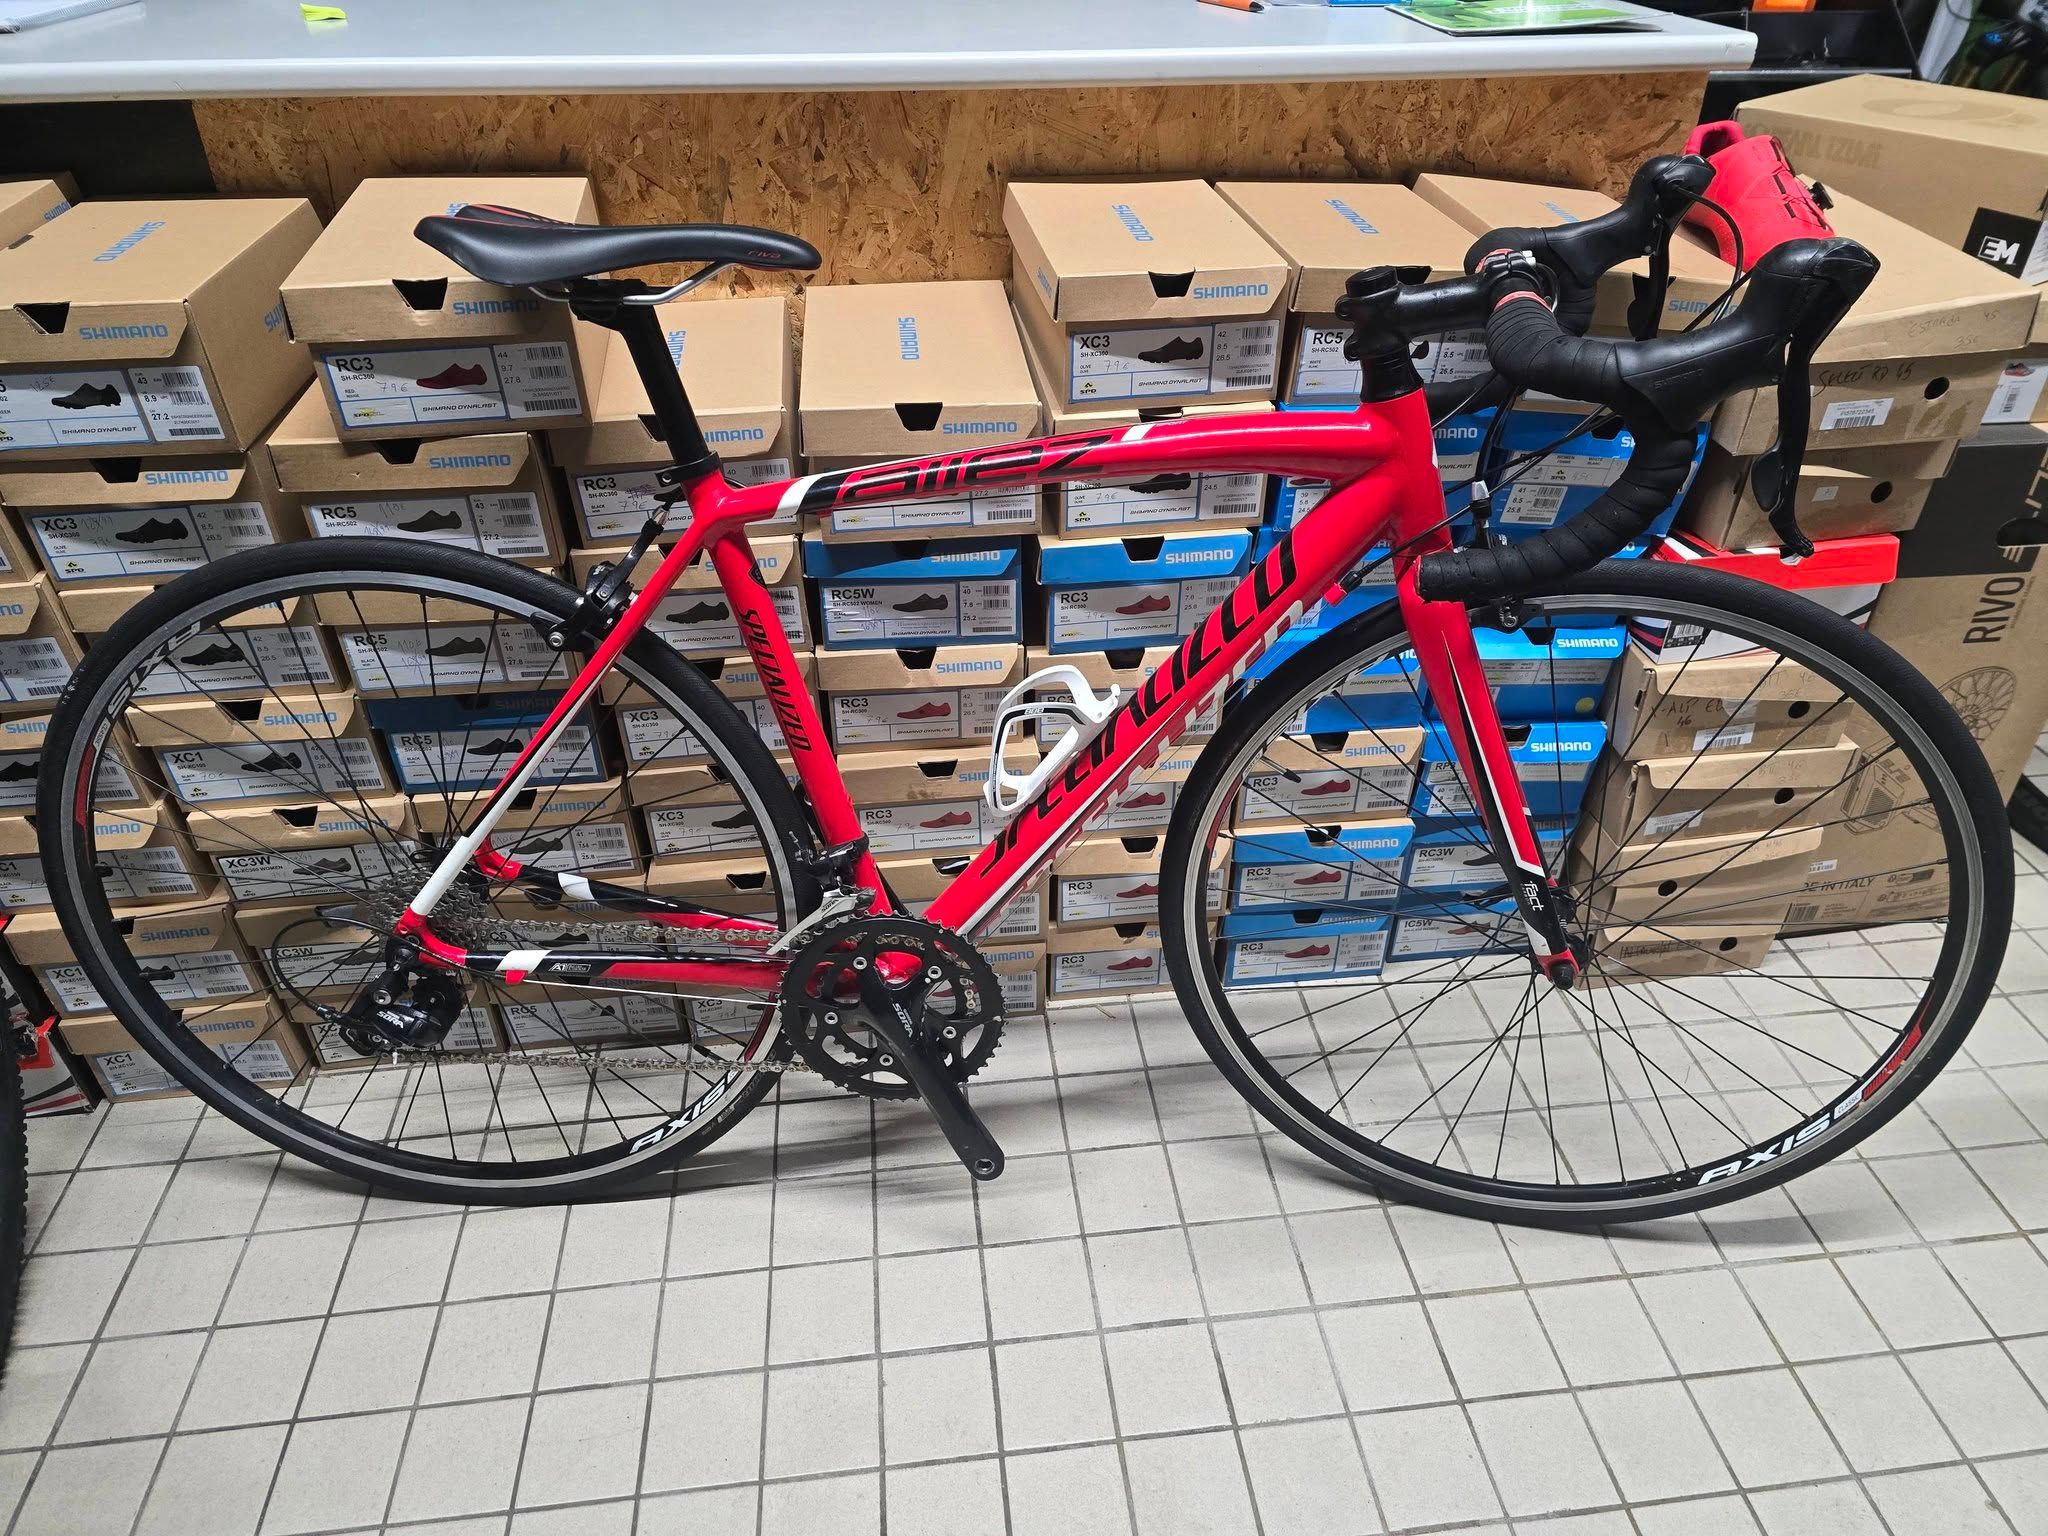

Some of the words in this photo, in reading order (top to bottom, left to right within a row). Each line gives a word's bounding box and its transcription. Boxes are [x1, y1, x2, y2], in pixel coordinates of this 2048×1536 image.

[1112, 204, 1154, 242] SHIMANO
[1325, 199, 1379, 235] SHIMANO
[94, 220, 166, 262] SHIMANO
[1193, 284, 1268, 299] SHIMANO
[453, 301, 541, 315] SHIMANO
[79, 324, 169, 341] SHIMANO
[1312, 332, 1343, 344] RC5
[898, 317, 920, 361] SHIMANO
[1080, 335, 1110, 349] XC3
[1443, 351, 1455, 359] 8.5
[336, 357, 375, 372] RC3
[137, 377, 148, 385] 43
[144, 394, 157, 403] 8.9
[458, 403, 498, 411] DYNALAST
[152, 412, 170, 421] 27.2
[62, 427, 96, 435] SHIMANO
[98, 426, 137, 434] DYNALAST
[942, 421, 1018, 434] SHIMANO
[429, 455, 512, 468] SHIMANO
[145, 469, 229, 485] SHIMANO
[583, 477, 617, 490] RC3
[975, 489, 989, 497] 27.2
[321, 506, 357, 519] RC5
[40, 517, 78, 532] XC3
[484, 533, 500, 541] 27.2
[129, 558, 163, 566] SHIMANO
[163, 556, 202, 564] DYNALAST
[931, 551, 1000, 563] SHIMANO
[1165, 549, 1233, 565] SHIMANO
[831, 588, 875, 600] RC5W
[1060, 592, 1089, 604] RC3
[1962, 576, 2026, 645] RIVO
[354, 634, 388, 646] RC5
[1557, 638, 1618, 648] SHIMANO
[936, 660, 1003, 673] SHIMANO
[841, 697, 869, 708] RC3
[264, 711, 337, 727] SHIMANO
[630, 710, 659, 722] XC3
[401, 735, 432, 747] RC5
[1530, 741, 1592, 753] SHIMANO
[1345, 744, 1406, 757] SHIMANO
[171, 752, 203, 764] XC1
[1253, 777, 1279, 788] RC3
[539, 801, 607, 813] SHIMANO
[657, 811, 684, 821] XC3
[865, 809, 893, 820] RC3
[319, 819, 389, 832] SHIMANO
[1341, 838, 1399, 850] SHIMANO
[1419, 847, 1455, 858] RC3W
[225, 855, 272, 868] XC3W
[1247, 867, 1272, 877] RC3
[1068, 881, 1092, 890] RC3
[141, 927, 210, 941] SHIMANO
[1241, 942, 1264, 952] RC3
[1061, 955, 1085, 964] RC3
[52, 968, 82, 979] XC1
[377, 1010, 404, 1029] SORA
[892, 1003, 914, 1038] SORA
[189, 1019, 255, 1034] SHIMANO
[105, 1053, 132, 1066] XC1
[629, 1079, 726, 1154] AXIS
[1698, 1113, 1830, 1186] AXIS
